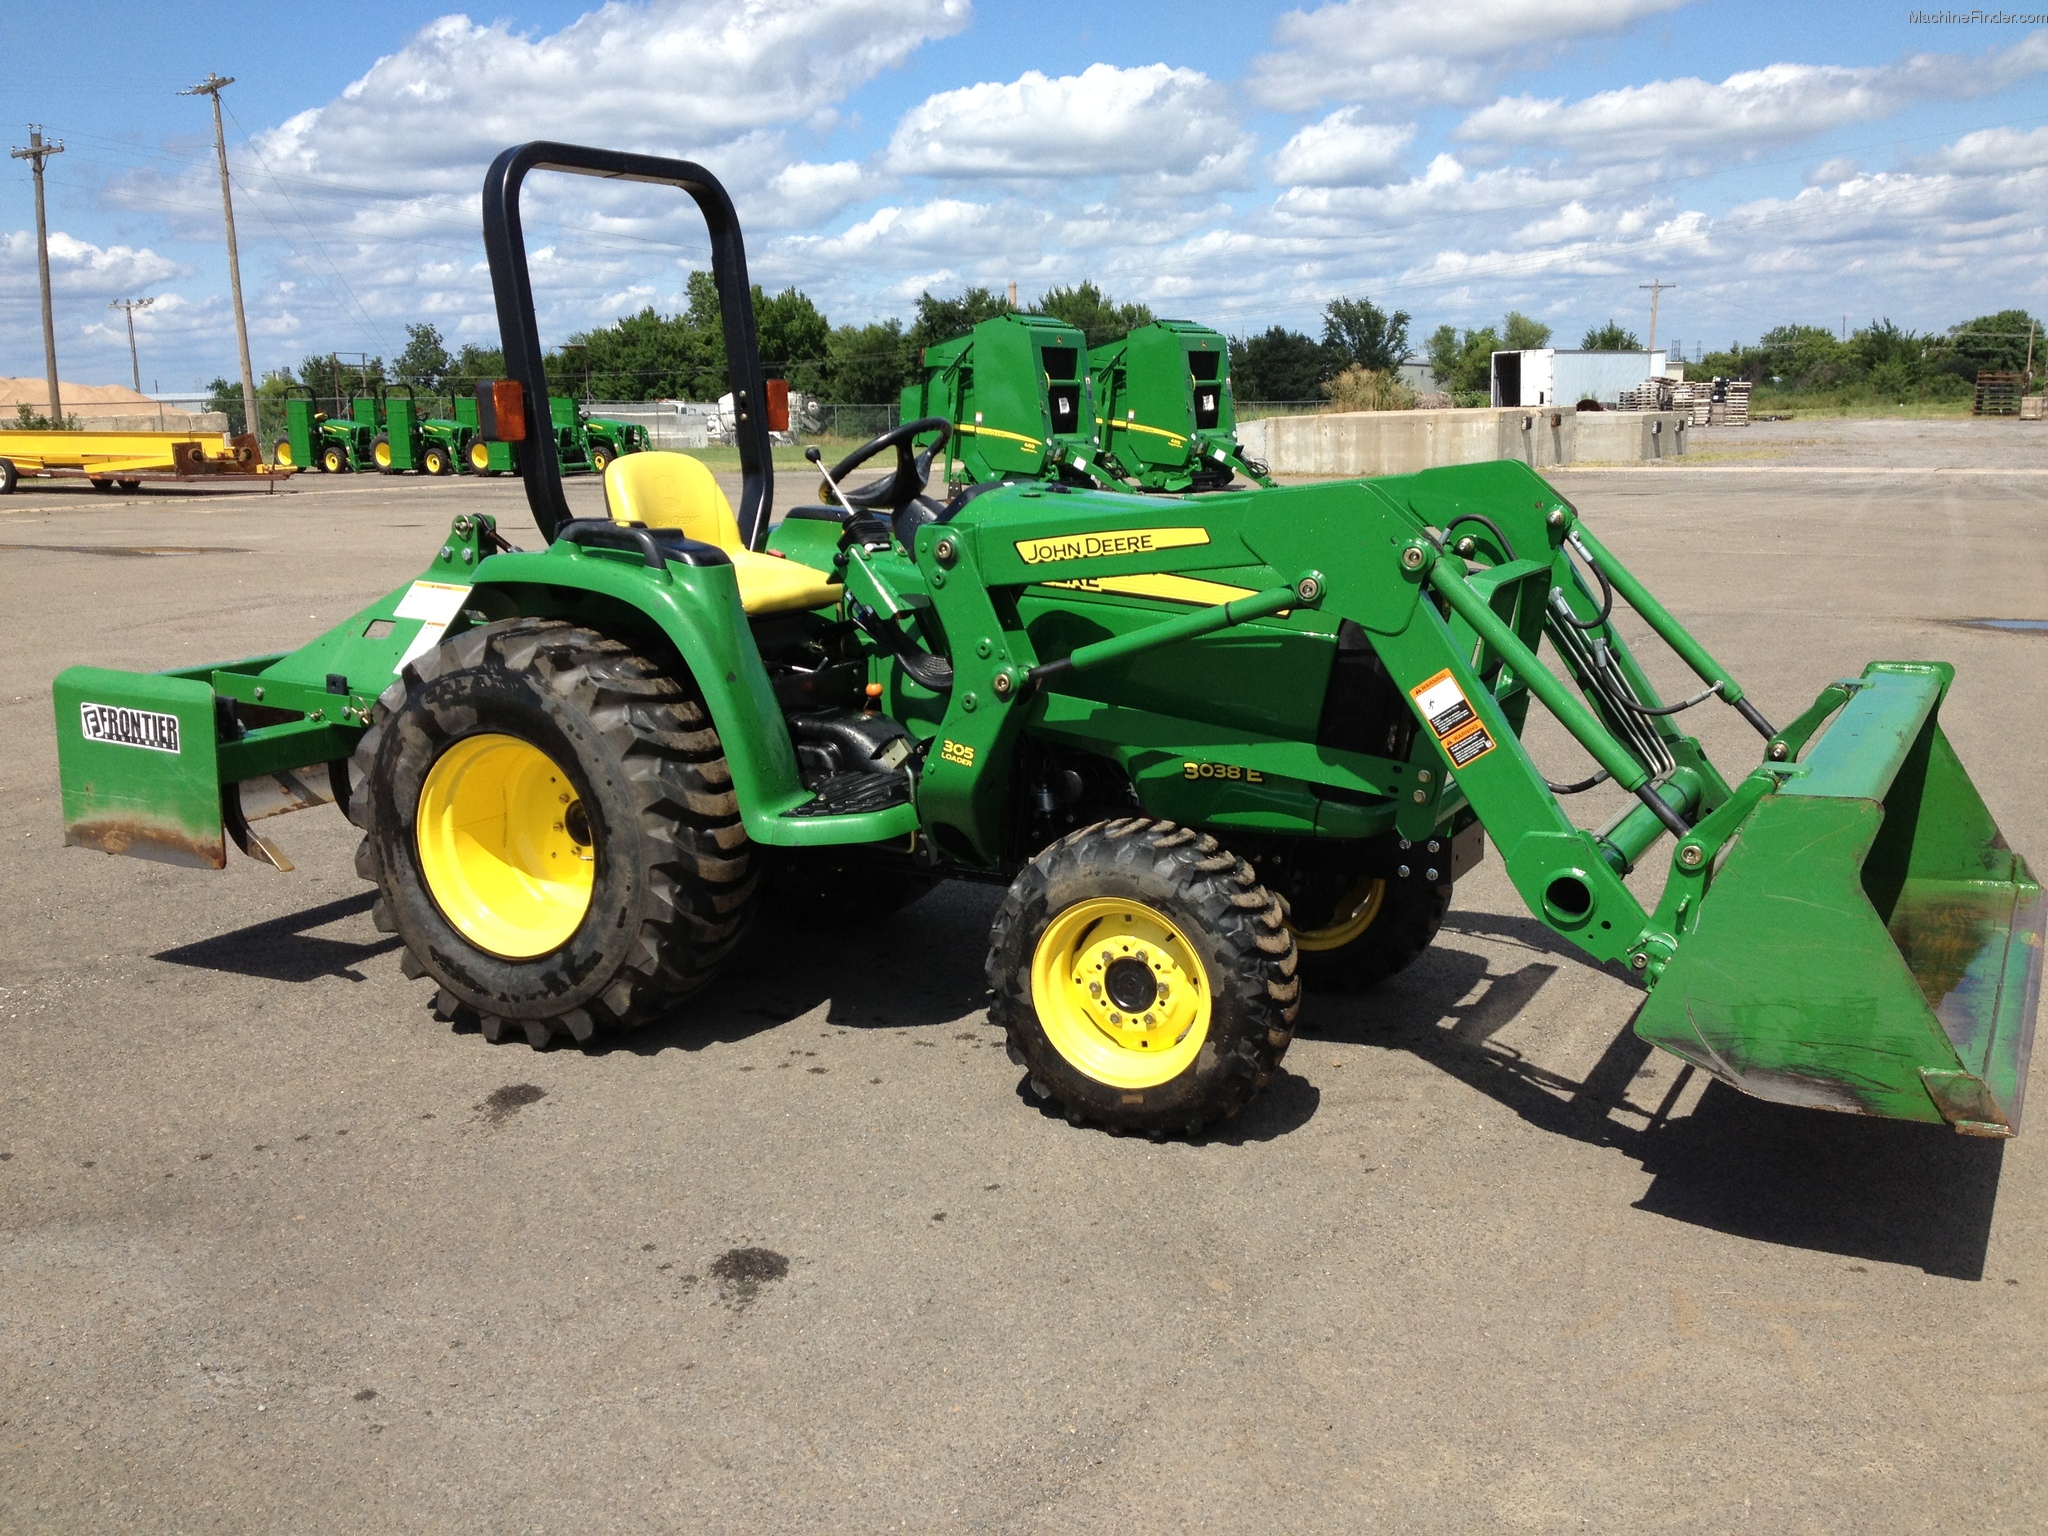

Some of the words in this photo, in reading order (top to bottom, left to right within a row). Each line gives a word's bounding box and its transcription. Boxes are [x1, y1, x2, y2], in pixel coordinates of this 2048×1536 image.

[1028, 541, 1085, 561] JOHN
[1085, 534, 1153, 555] DEERE
[1421, 673, 1446, 691] WARNING
[98, 706, 179, 751] FRONTIER
[1453, 724, 1479, 741] WARNING
[943, 739, 974, 759] 305
[941, 752, 973, 767] LOADER
[1183, 762, 1241, 779] 3038
[1246, 768, 1263, 782] E
